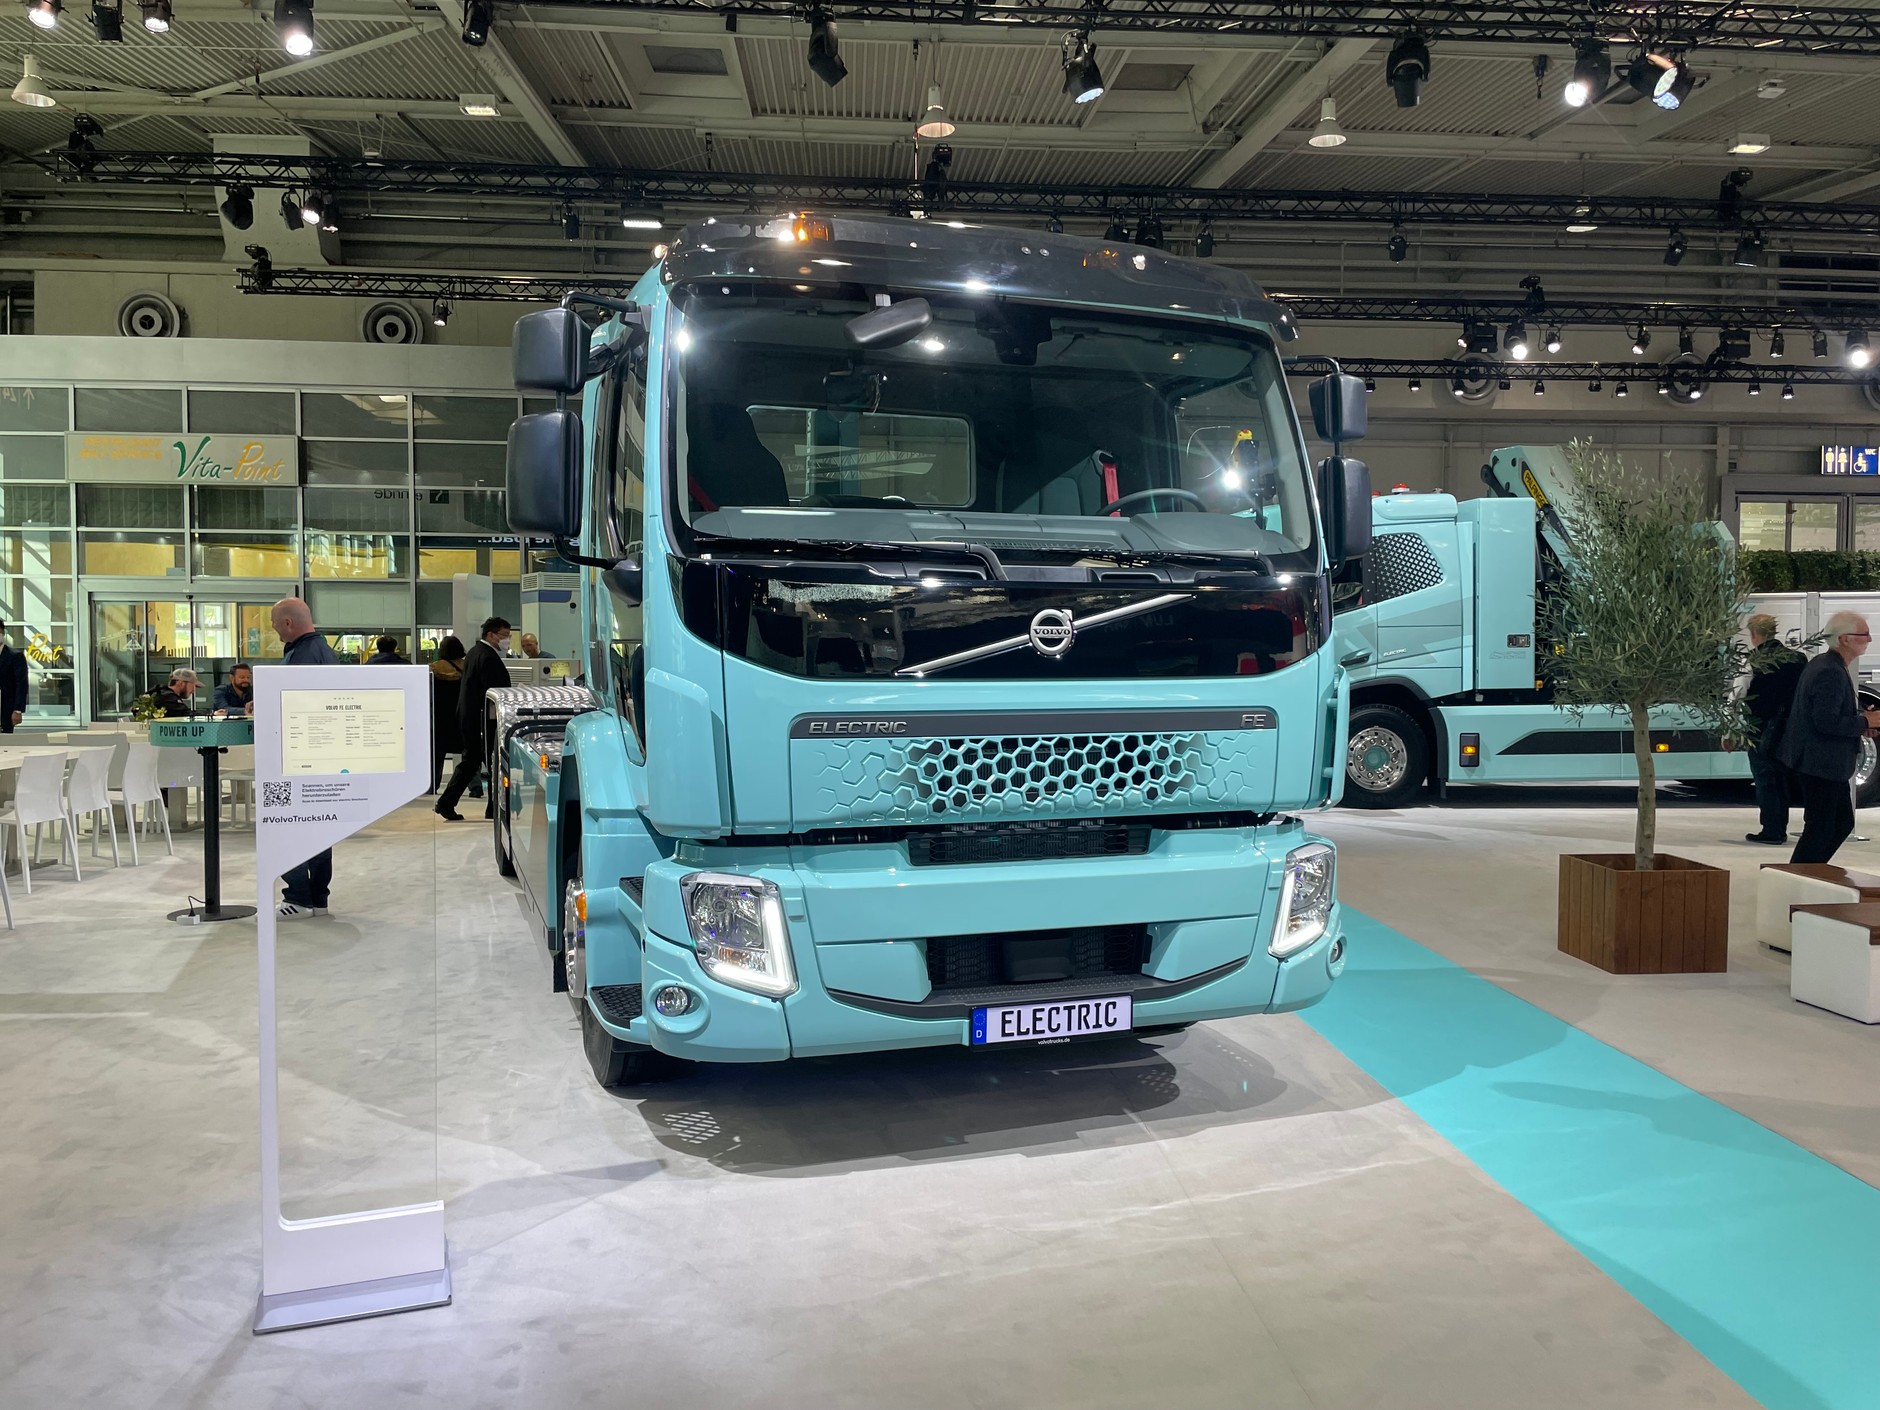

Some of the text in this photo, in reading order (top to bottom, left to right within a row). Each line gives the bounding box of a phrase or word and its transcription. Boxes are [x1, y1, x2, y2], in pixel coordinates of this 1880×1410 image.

[173, 435, 286, 482] Vita-Point
[1240, 714, 1267, 727] FE
[160, 725, 205, 737] POWER UP
[809, 721, 907, 734] ELECTRIC
[262, 813, 338, 824] #VolvoTrucksIAA
[1001, 1001, 1117, 1038] ELECTRIC
[975, 1029, 983, 1039] D
[1037, 1037, 1070, 1045] volvotrucks.de
